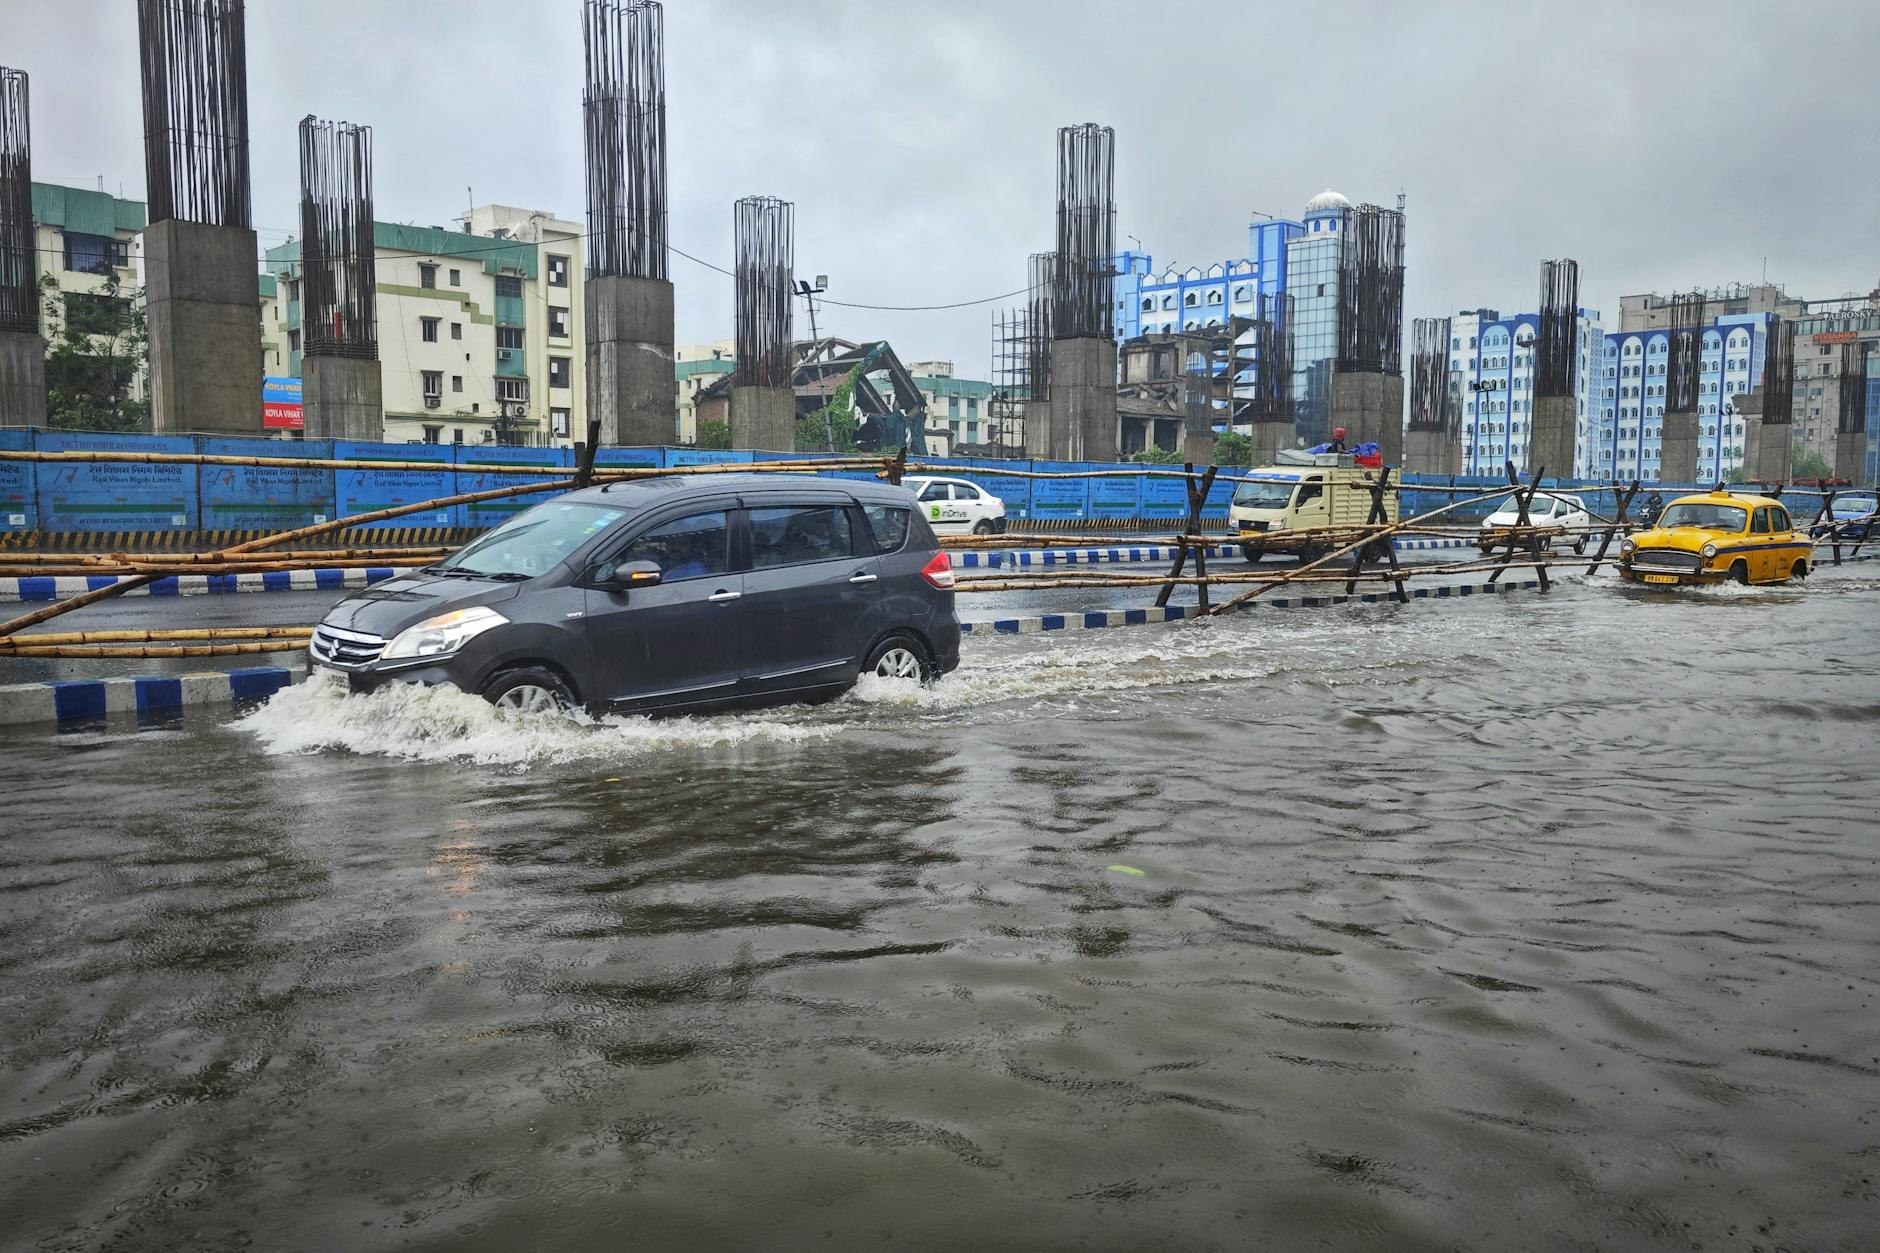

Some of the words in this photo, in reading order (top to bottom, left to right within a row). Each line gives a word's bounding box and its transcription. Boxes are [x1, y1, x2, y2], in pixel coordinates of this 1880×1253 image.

[1828, 309, 1873, 320] AEROSKY
[265, 408, 283, 418] KOYLA
[283, 409, 301, 419] VIHAR
[60, 440, 91, 449] METRO
[92, 441, 114, 450] WORK
[942, 509, 967, 518] inDrive
